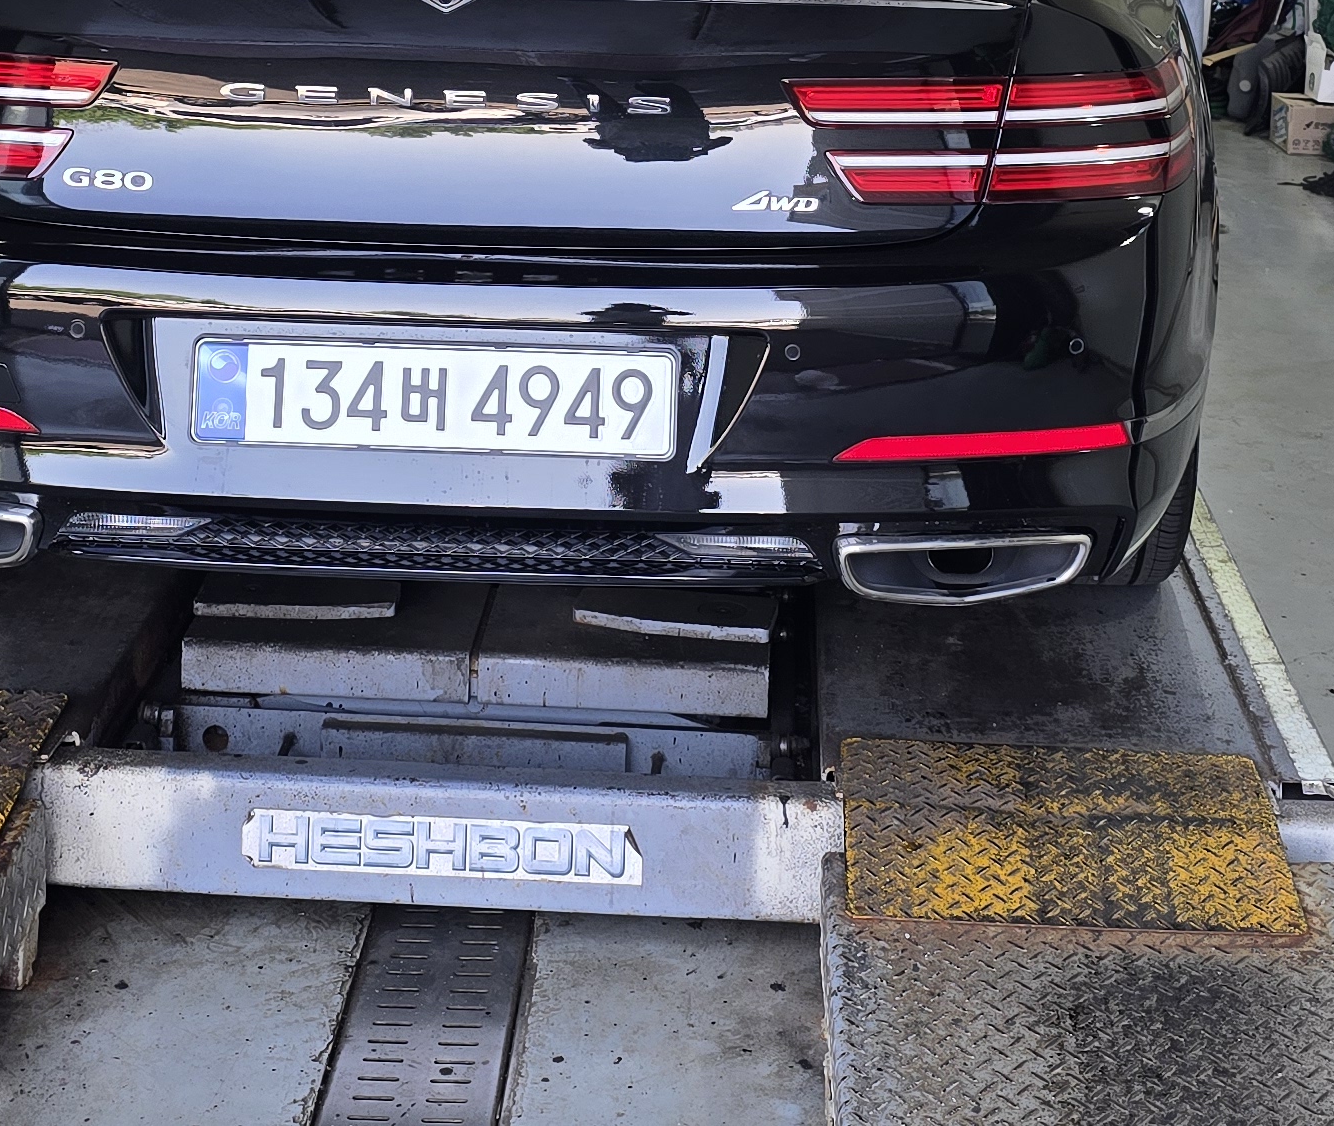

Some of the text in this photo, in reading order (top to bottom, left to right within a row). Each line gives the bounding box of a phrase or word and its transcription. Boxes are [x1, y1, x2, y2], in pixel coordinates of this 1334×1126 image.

[218, 81, 673, 117] GENESIS
[62, 166, 154, 192] G80
[731, 190, 819, 213] 4WD
[260, 357, 654, 441] 134버 4949
[200, 411, 242, 430] KOR
[257, 814, 627, 879] HESHBON
